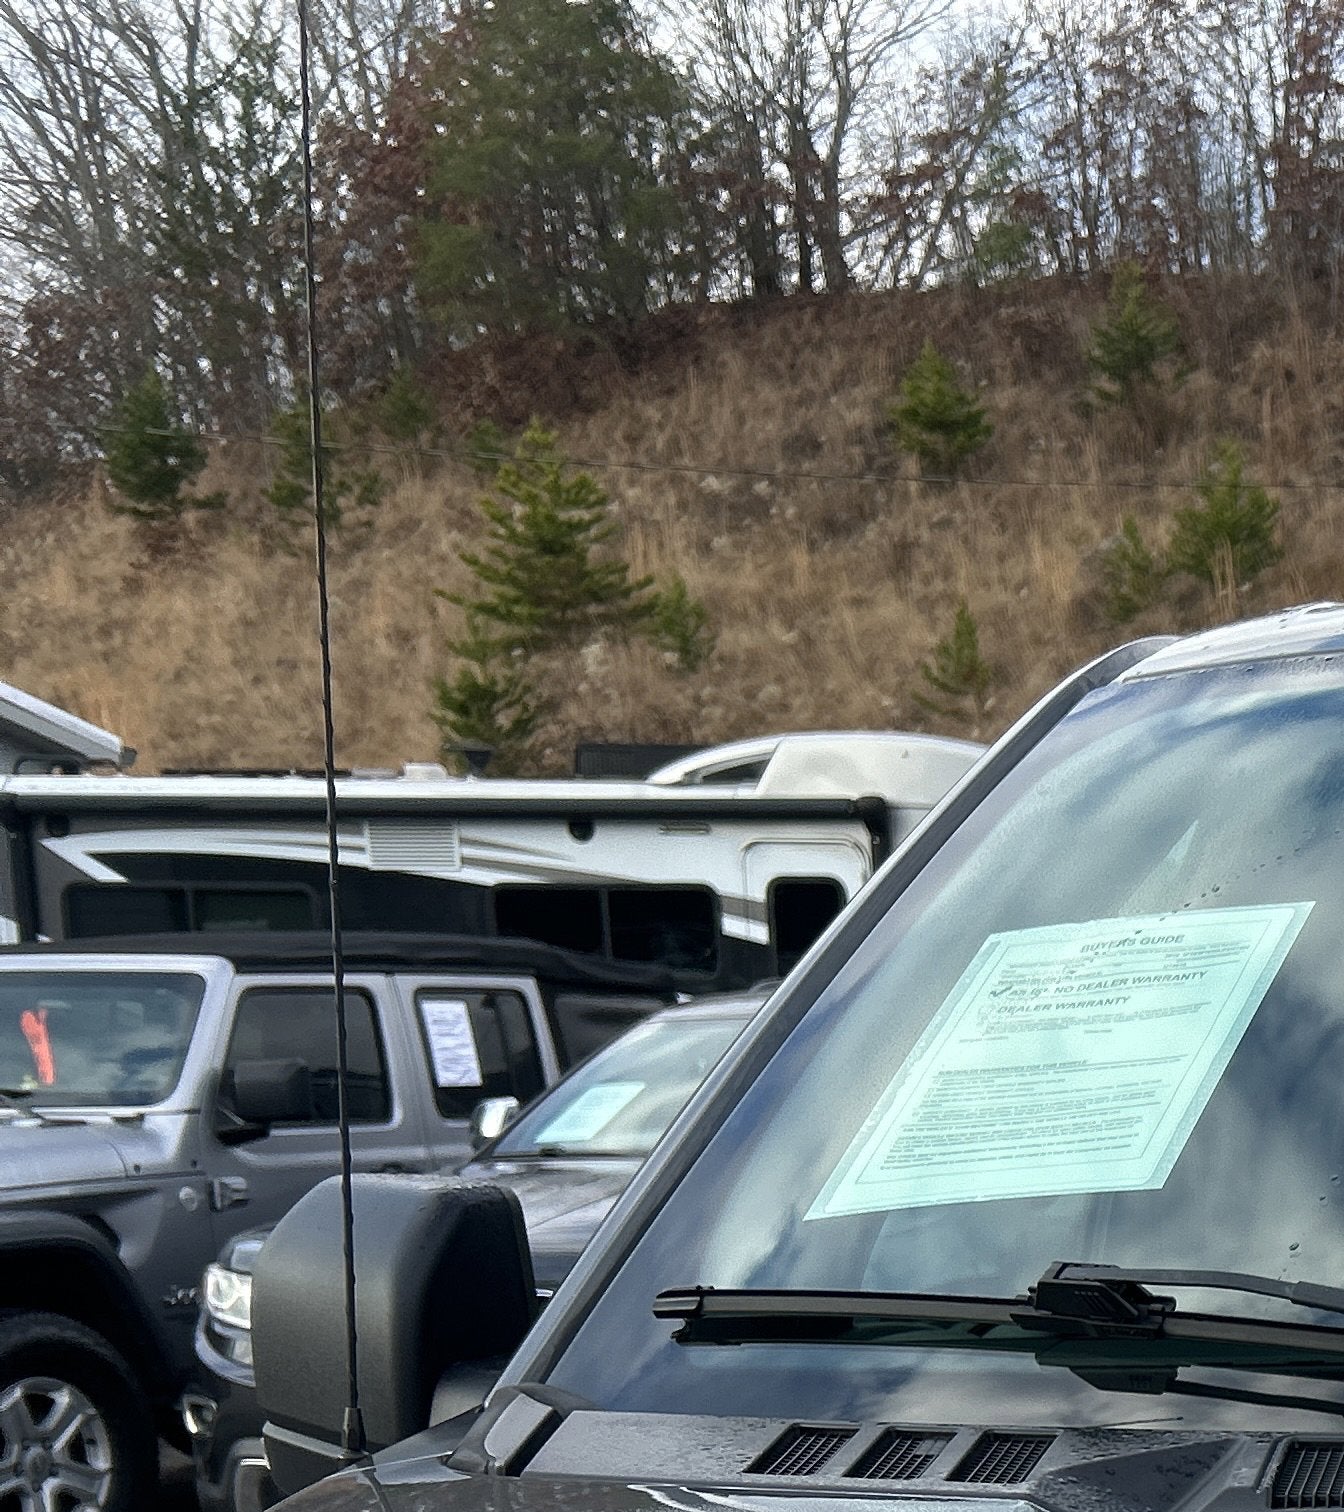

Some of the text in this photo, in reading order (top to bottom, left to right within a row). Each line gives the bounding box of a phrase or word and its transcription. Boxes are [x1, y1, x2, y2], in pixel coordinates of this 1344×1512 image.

[1139, 934, 1185, 946] GUIDE
[1077, 977, 1129, 992] DEALER
[1132, 970, 1208, 985] WARRANTY
[1055, 995, 1131, 1009] WARRANTY
